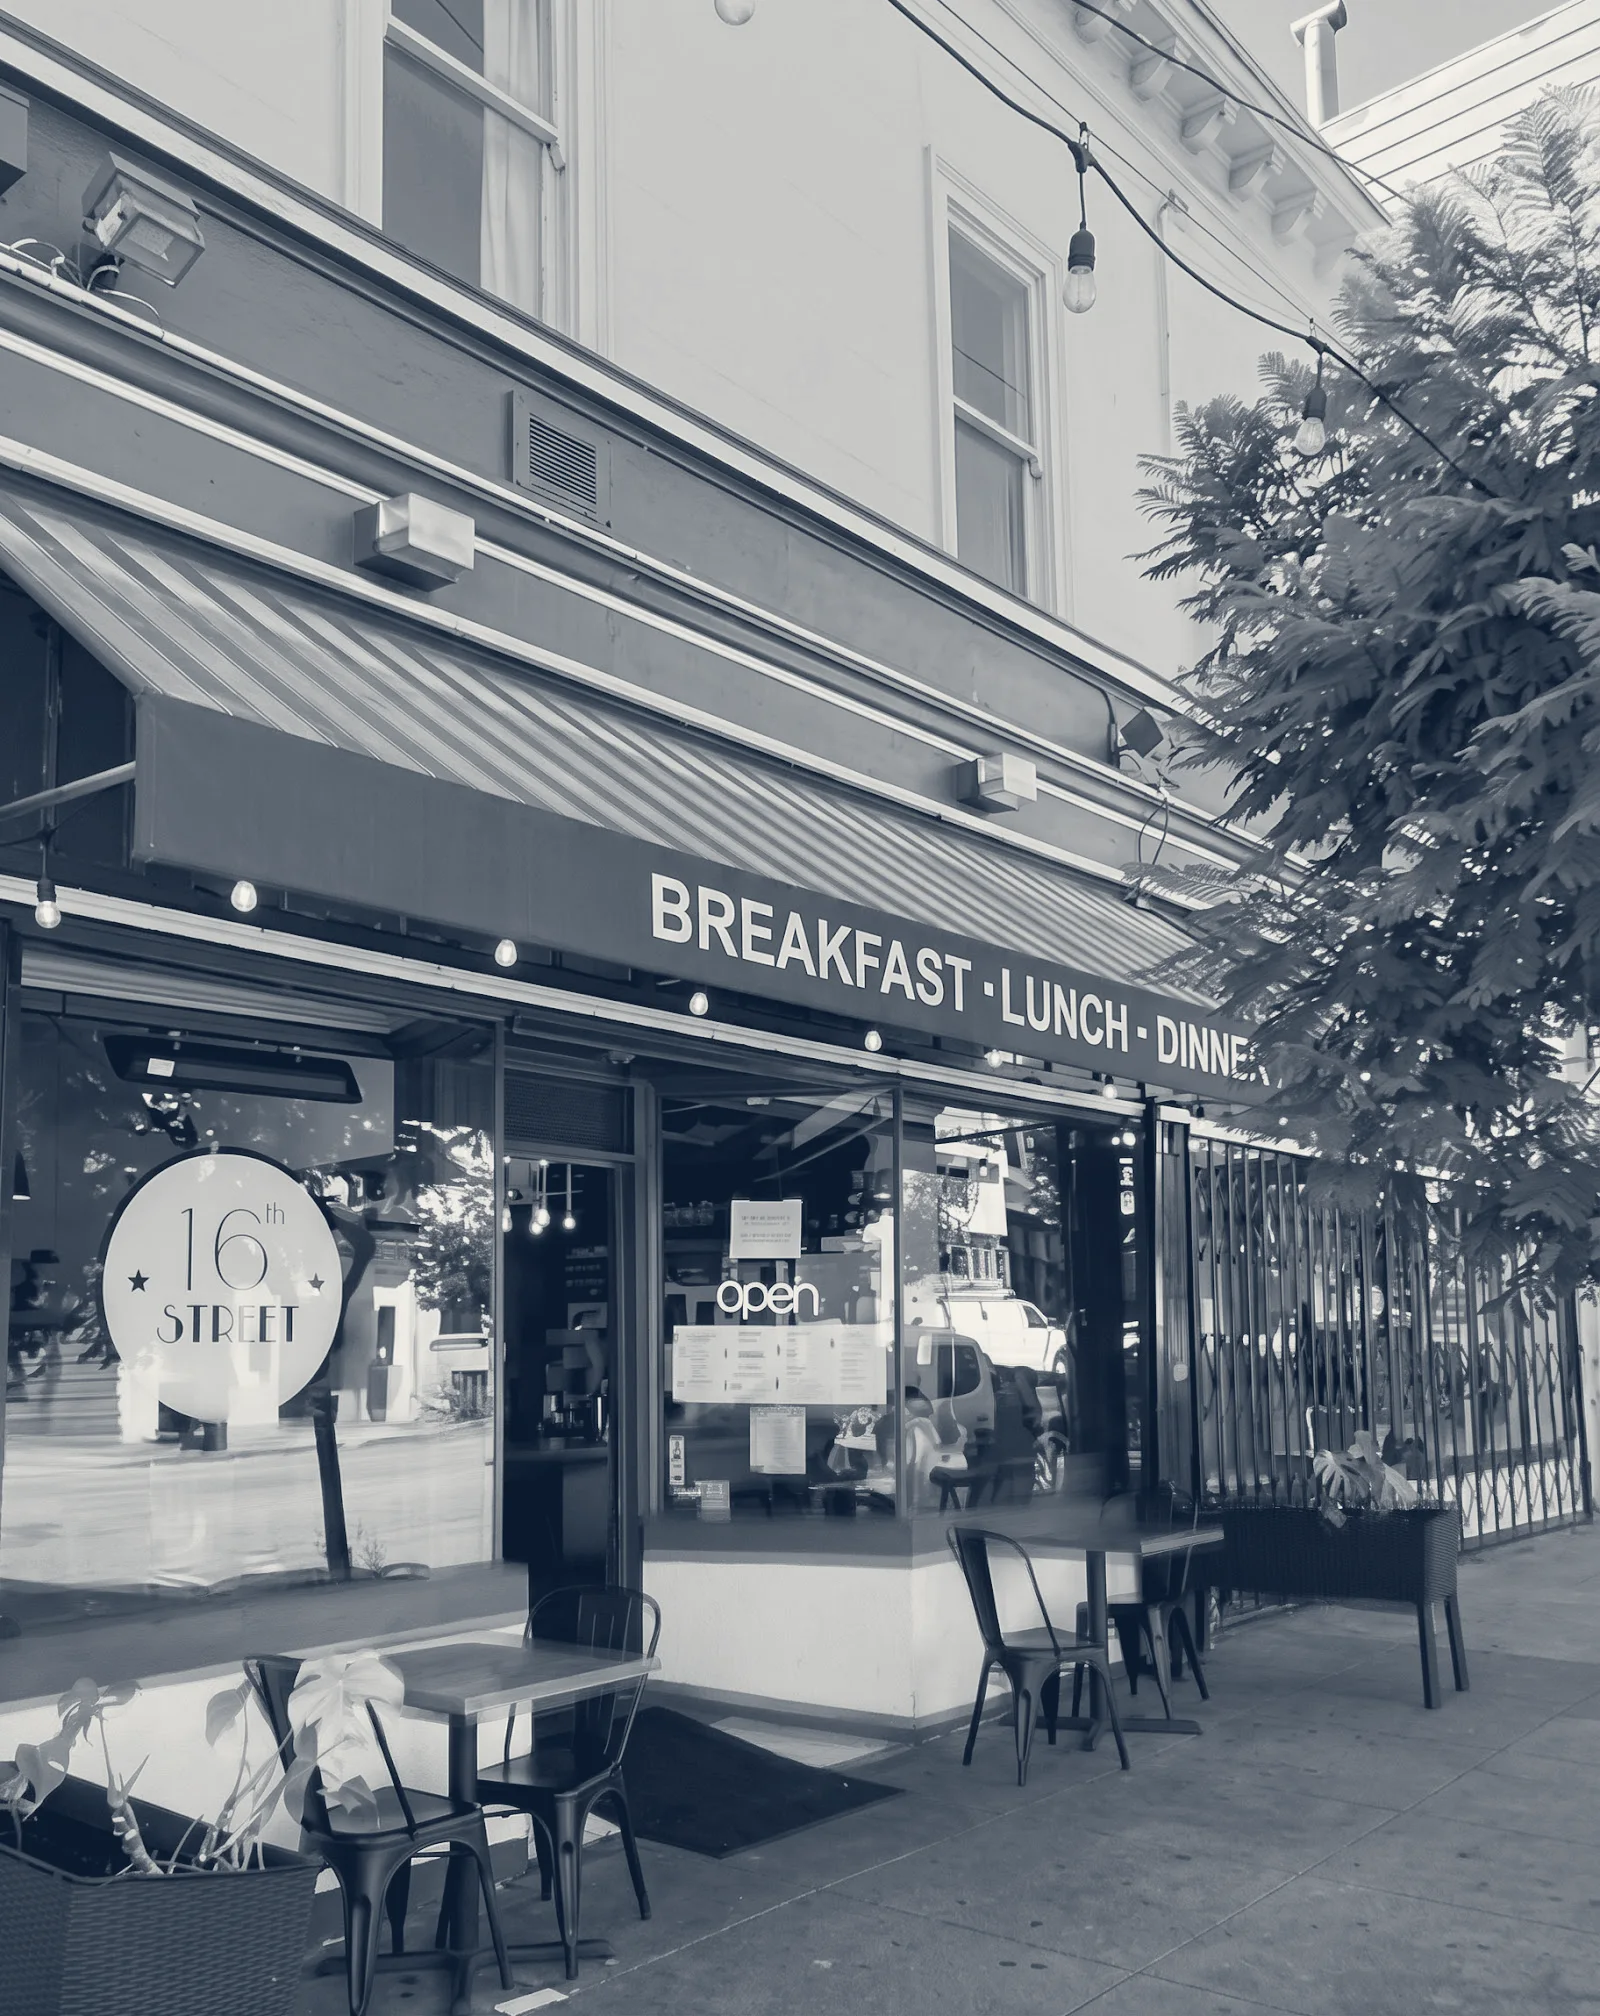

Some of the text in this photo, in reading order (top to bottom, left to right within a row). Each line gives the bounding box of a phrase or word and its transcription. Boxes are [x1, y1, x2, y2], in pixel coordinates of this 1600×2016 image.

[650, 872, 972, 1012] BREAKFAST
[1001, 968, 1129, 1053] LUNCH
[181, 1202, 285, 1291] 16th
[157, 1304, 299, 1344] STREET
[716, 1280, 819, 1320] open
